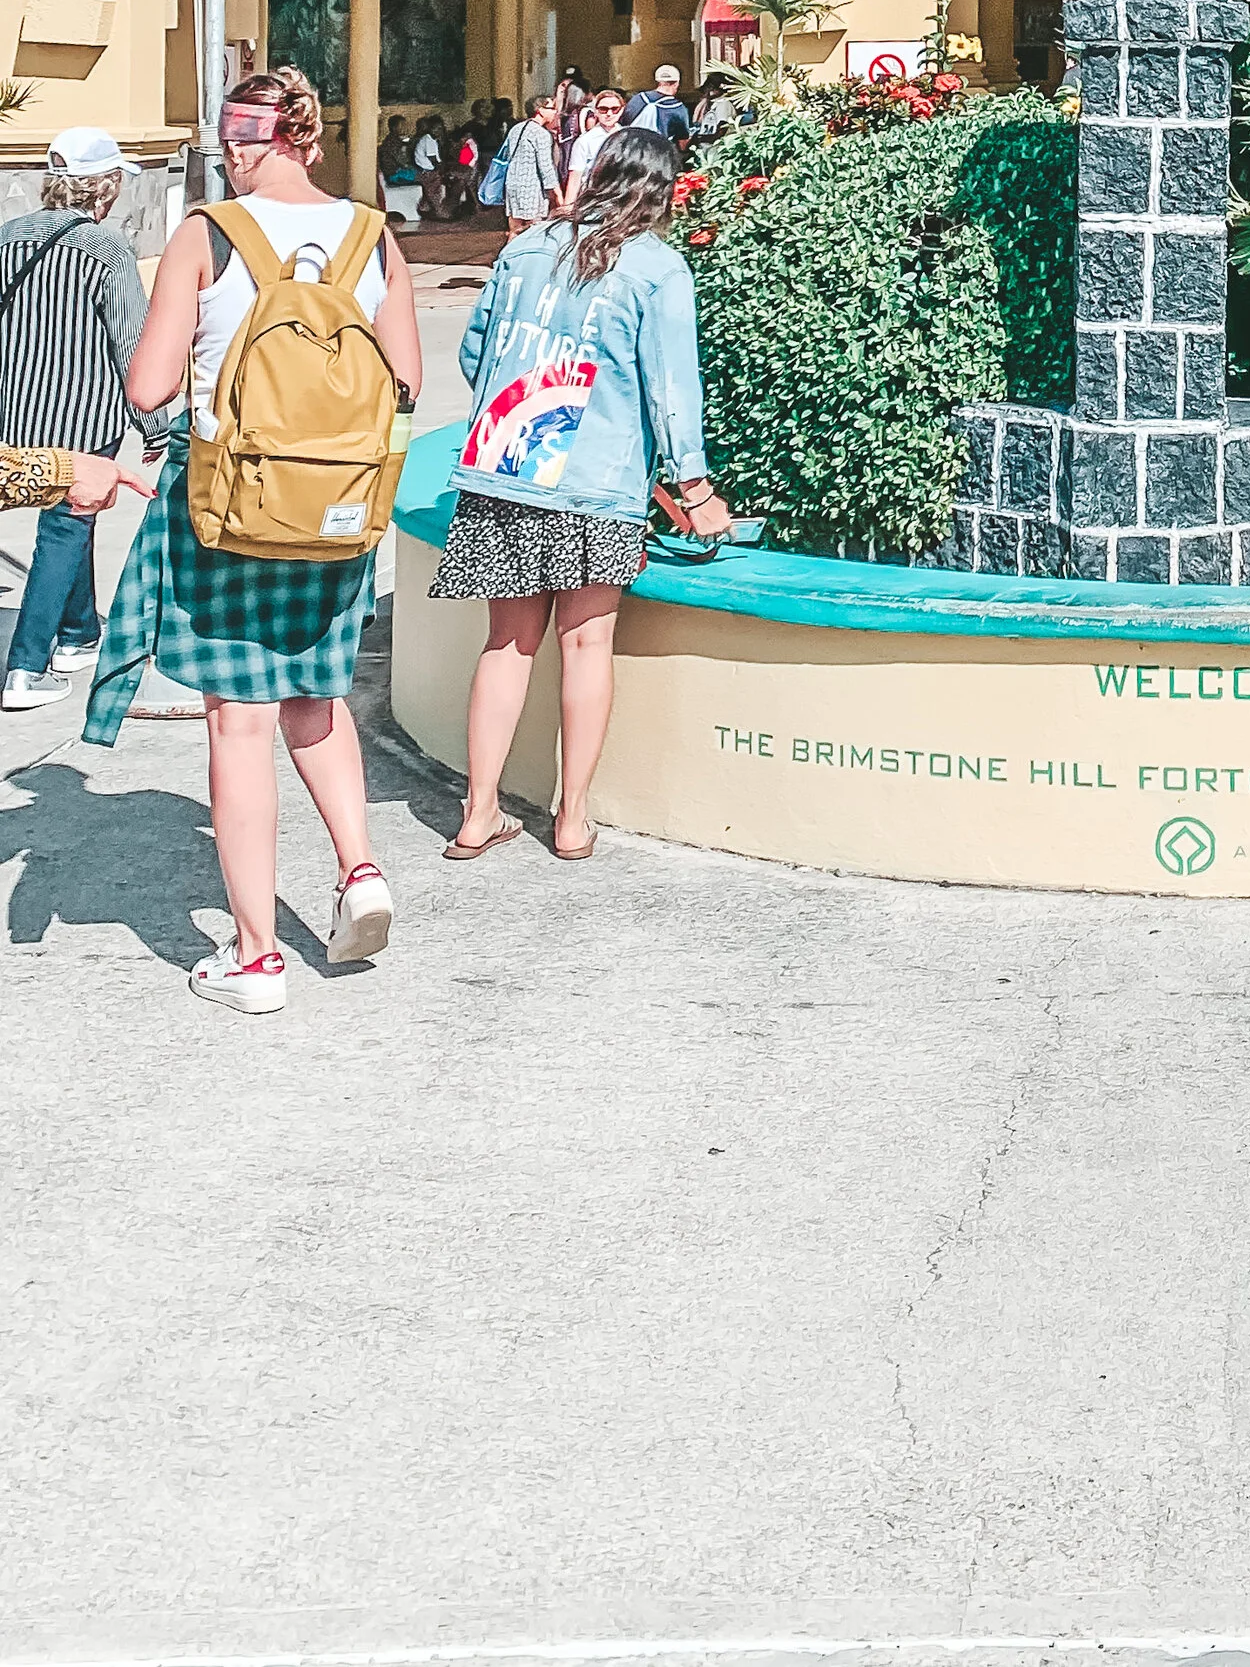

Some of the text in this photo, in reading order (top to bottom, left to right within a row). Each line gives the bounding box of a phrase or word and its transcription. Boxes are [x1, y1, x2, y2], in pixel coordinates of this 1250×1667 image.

[714, 725, 774, 758] THE
[792, 737, 1008, 782] BRIMSTONE
[1030, 759, 1117, 789] HILL
[1233, 845, 1248, 859] A
